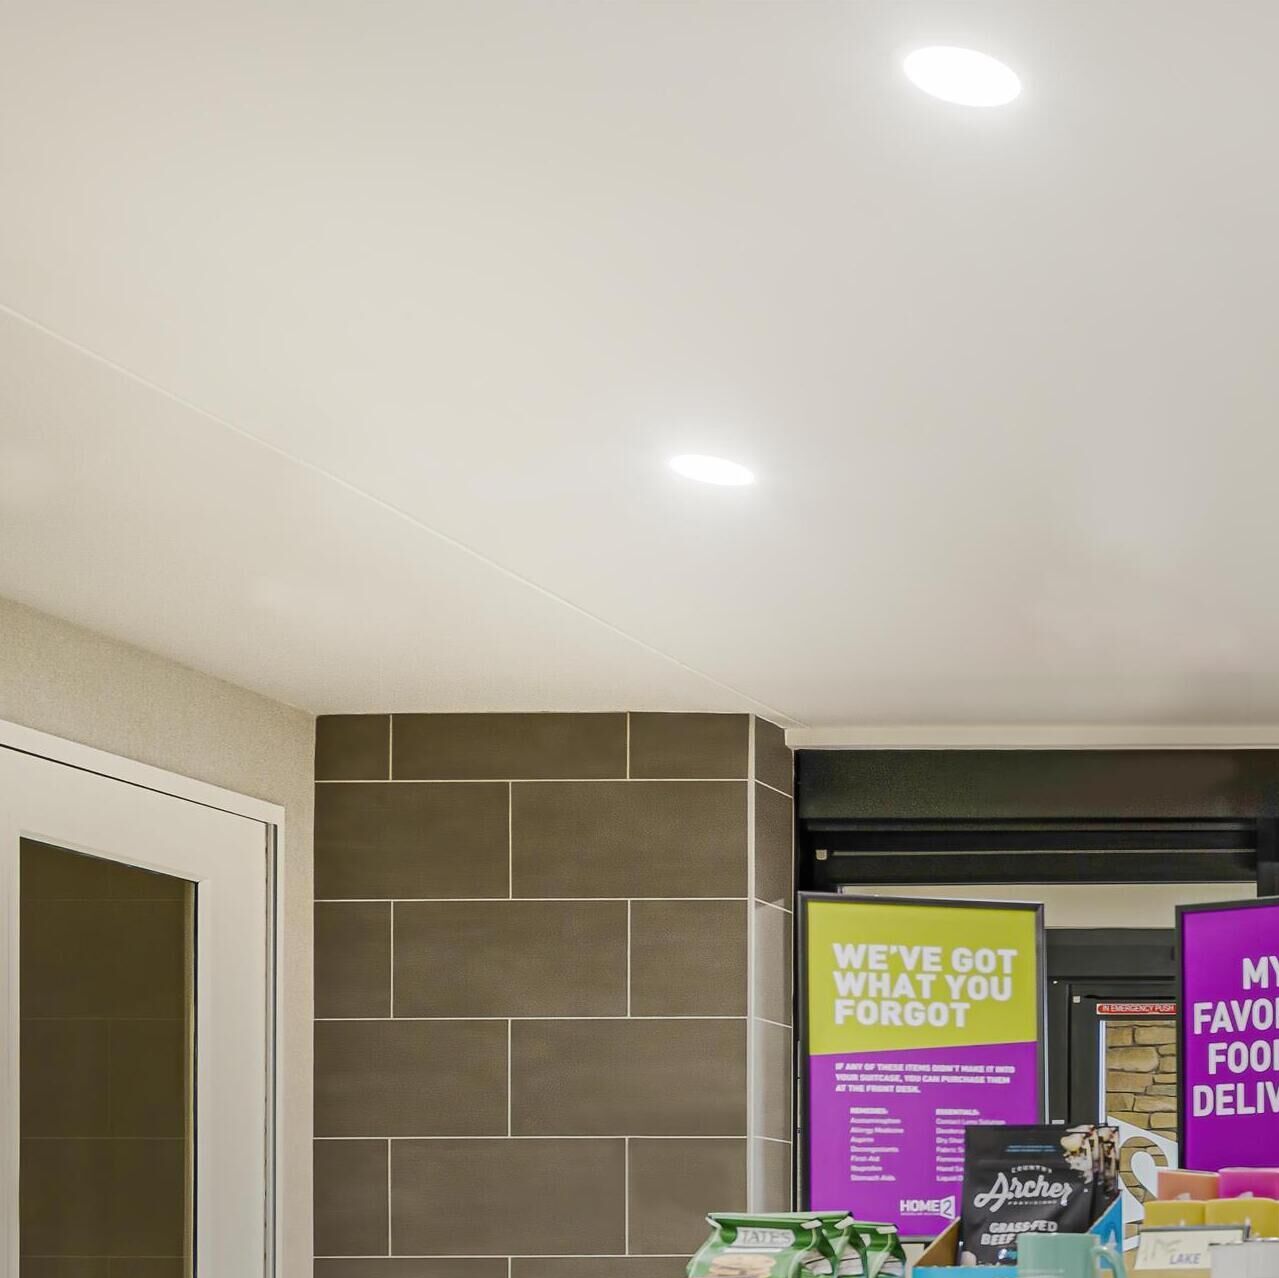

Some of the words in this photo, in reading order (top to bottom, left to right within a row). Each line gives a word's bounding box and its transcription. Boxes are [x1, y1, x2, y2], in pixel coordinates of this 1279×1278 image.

[832, 943, 942, 973] WE'VE
[950, 948, 1018, 975] GOT
[833, 971, 937, 999] WHAT
[945, 973, 1012, 1002] YOU
[834, 1000, 970, 1027] FORGOT
[1111, 1004, 1152, 1013] EMERGENCY
[973, 1172, 1073, 1213] Archer
